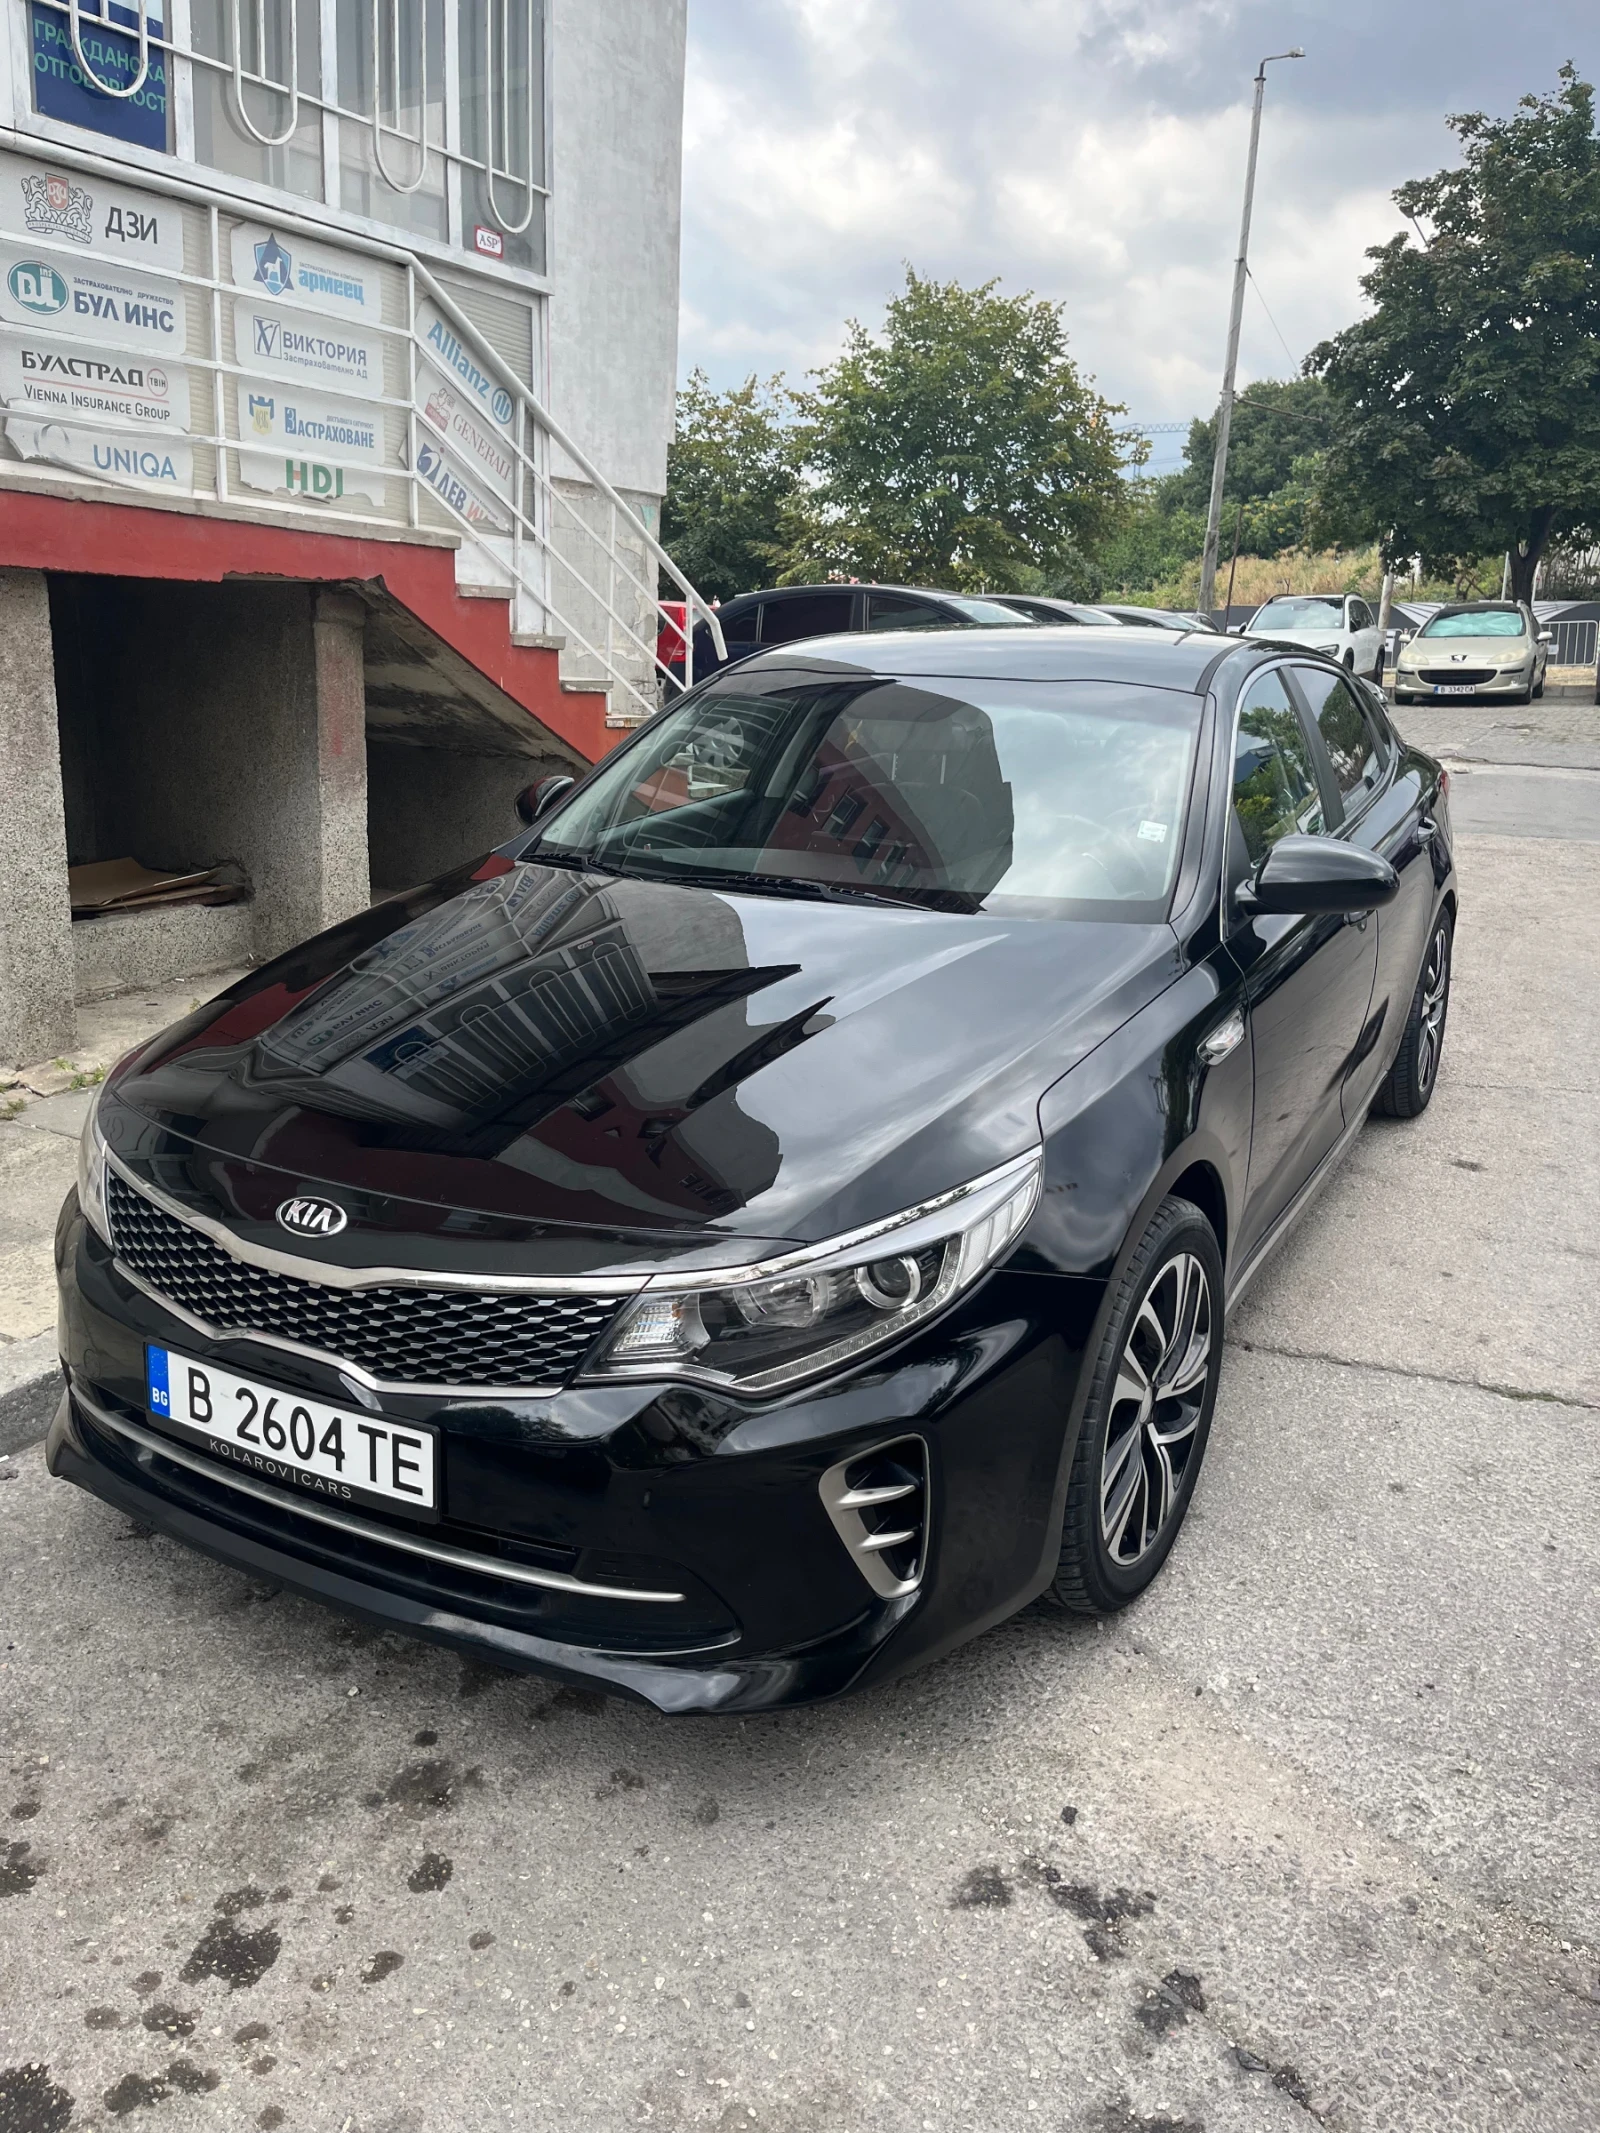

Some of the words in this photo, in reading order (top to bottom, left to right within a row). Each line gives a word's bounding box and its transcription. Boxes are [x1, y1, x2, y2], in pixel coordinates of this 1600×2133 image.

[105, 206, 158, 244] ДЗИ
[479, 233, 498, 249] ASP
[73, 276, 133, 296] ЗАСТРАХОВАТЕЛНО
[137, 291, 174, 306] ДРУЖЕСТВО
[298, 269, 364, 305] армеец
[74, 290, 120, 321] БУЛ
[124, 302, 175, 333] ИНС
[283, 331, 367, 366] ВИКТОРИЯ
[283, 352, 354, 376] Застрахователно
[356, 368, 368, 379] АД
[427, 319, 490, 399] Allianz
[21, 350, 144, 387] БУЛСТРАД
[285, 407, 375, 449] ЗАСТРАХОВАНЕ
[93, 444, 177, 481] UNIQA
[453, 414, 511, 481] GENERALI
[286, 459, 343, 497] HDI
[437, 472, 467, 511] ЛЕВ
[284, 1200, 332, 1231] KIA
[152, 1386, 168, 1406] BG
[187, 1366, 213, 1423] B
[235, 1387, 346, 1473] 2604
[357, 1423, 423, 1496] TE
